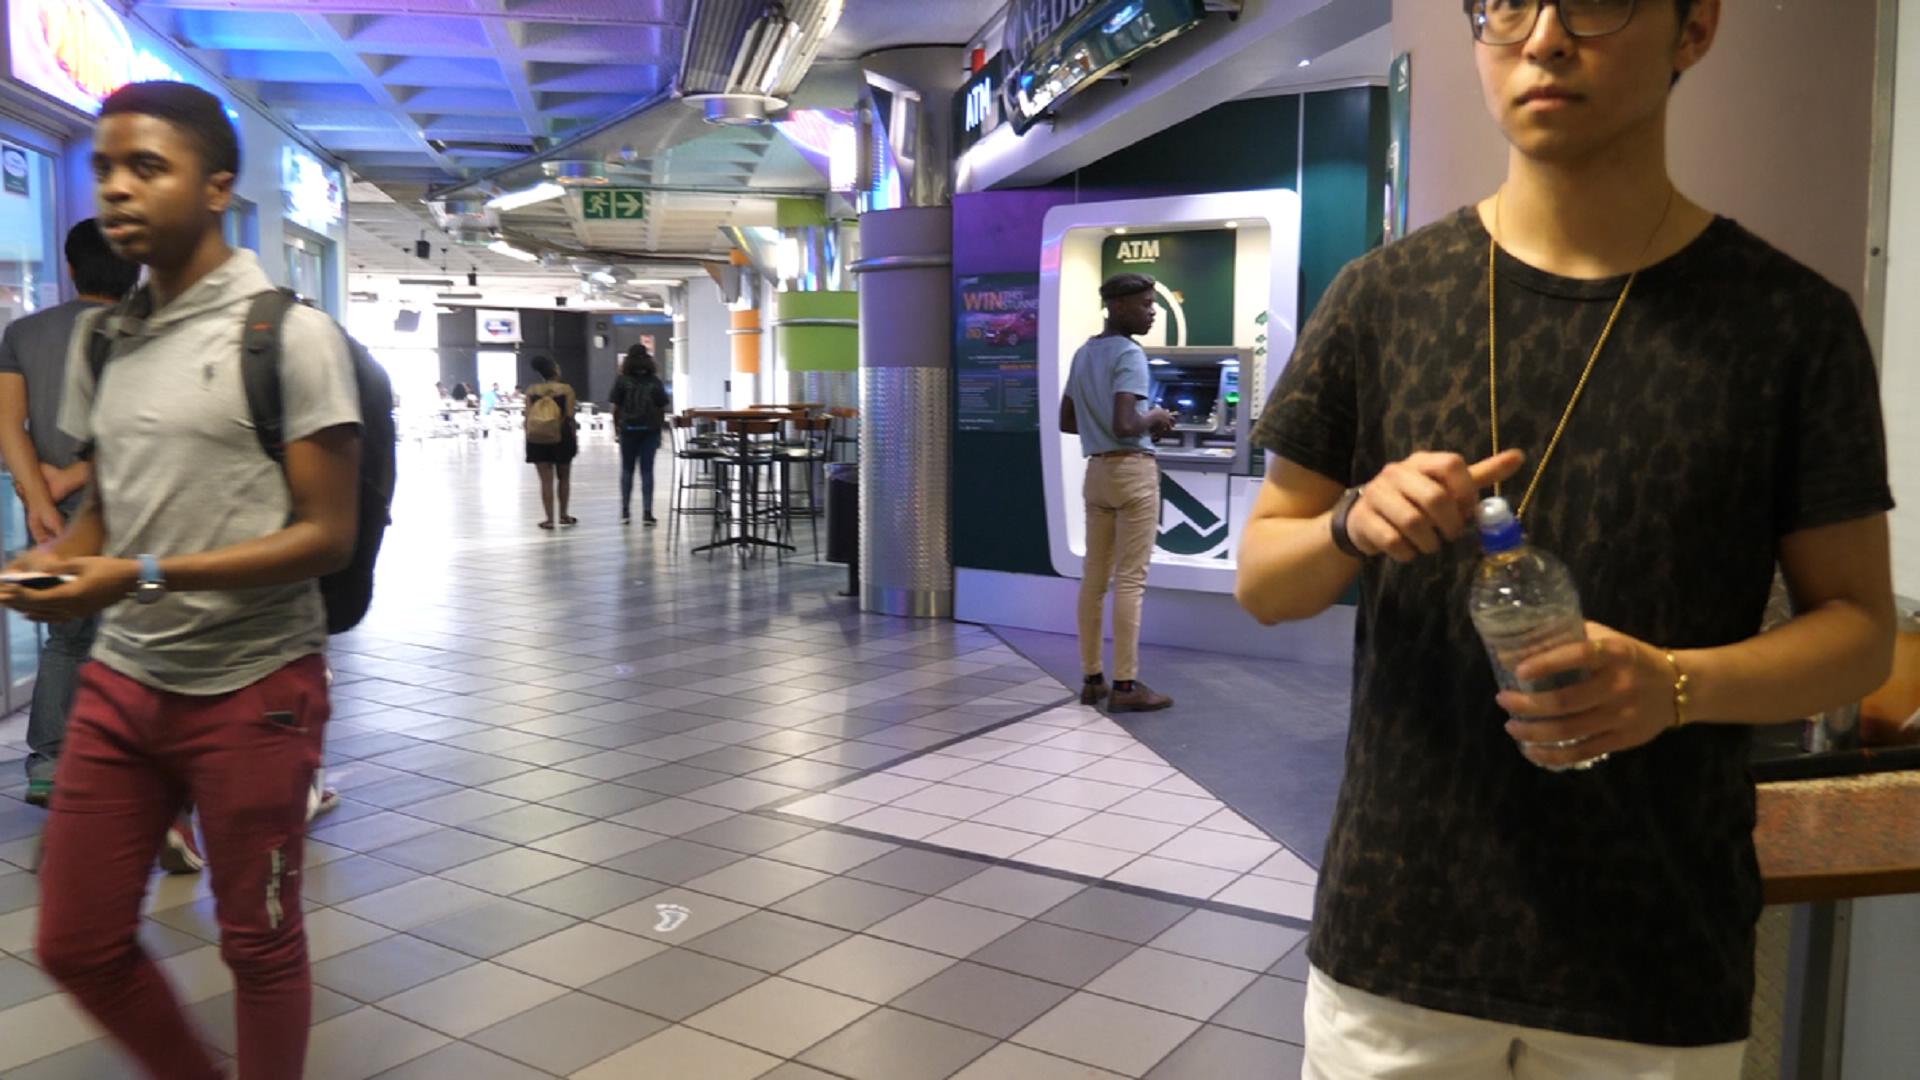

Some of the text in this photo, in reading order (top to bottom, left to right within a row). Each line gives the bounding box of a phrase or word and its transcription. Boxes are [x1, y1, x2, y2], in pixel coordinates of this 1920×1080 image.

[966, 77, 991, 131] ATM
[1116, 240, 1160, 259] ATM
[963, 291, 1003, 311] WIN
